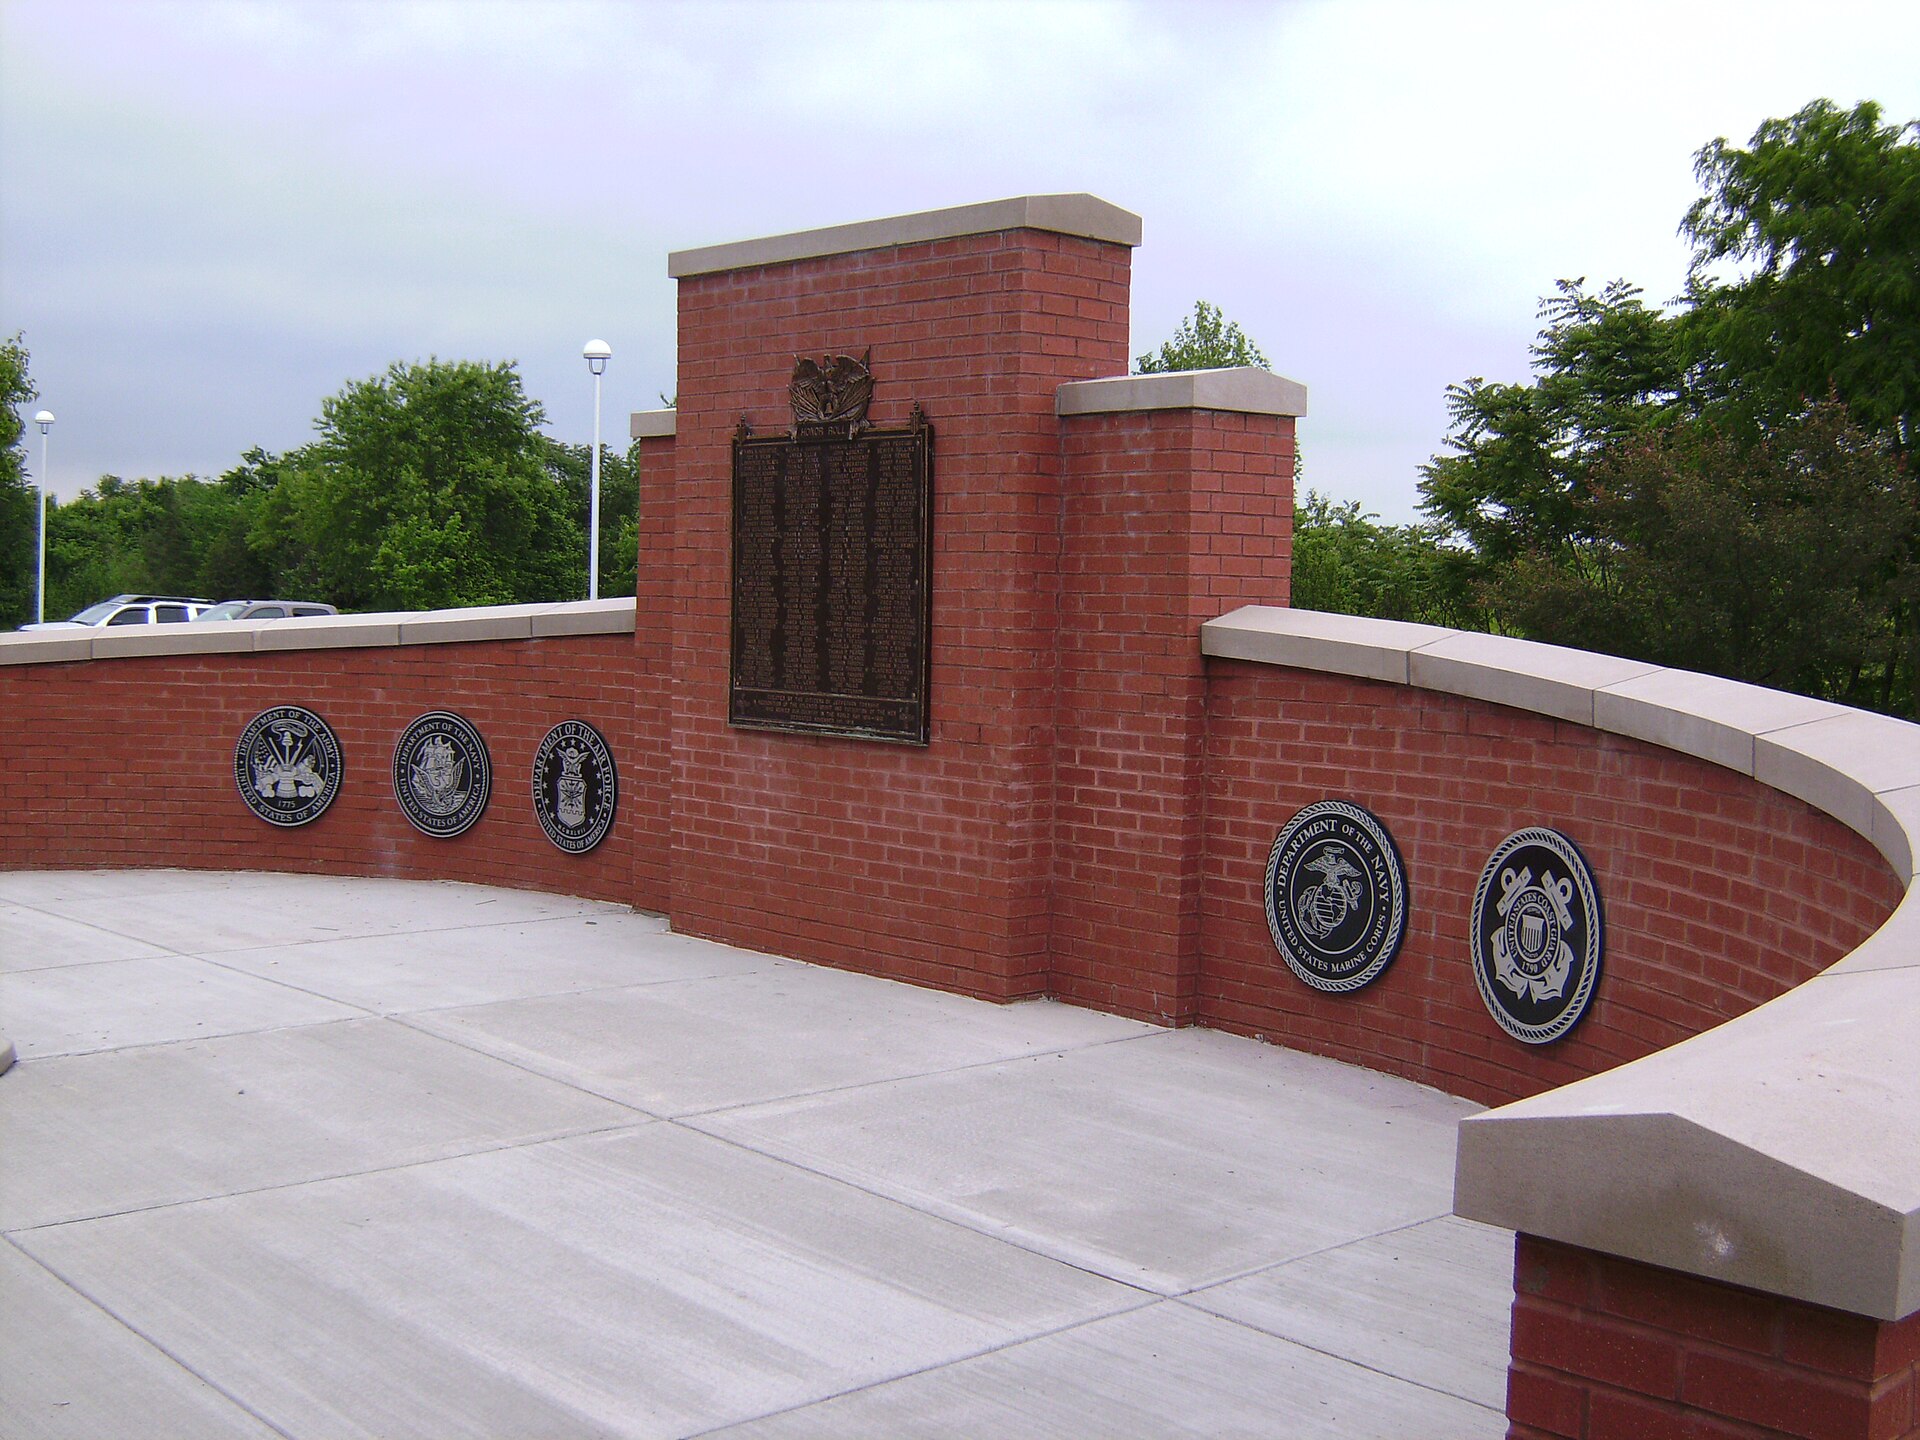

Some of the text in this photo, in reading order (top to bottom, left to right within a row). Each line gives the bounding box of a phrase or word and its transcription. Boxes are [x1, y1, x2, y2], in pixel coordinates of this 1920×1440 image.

[241, 710, 336, 759] DEPARTMENT OF THE ARMY
[401, 722, 481, 770] DEPARTMENT OF THE NAVY
[534, 724, 612, 811] DEPARTMENT OF THE AIR FORCE
[239, 768, 336, 821] UNITED STATES OF AMERICA
[278, 800, 296, 808] 1775
[400, 778, 481, 827] UNITED STATES OF AMERICA
[539, 810, 606, 849] UNITED STATES OF AMERICA
[1278, 819, 1390, 904] DEPARTMENT OF THE NAVY
[1513, 892, 1537, 912] STATES
[1537, 895, 1557, 926] COAST
[1278, 900, 1387, 973] UNITED STATES MARINE CORPS
[1508, 912, 1518, 958] UNITED
[1541, 927, 1558, 968] GUARD
[1521, 961, 1538, 973] 1790
